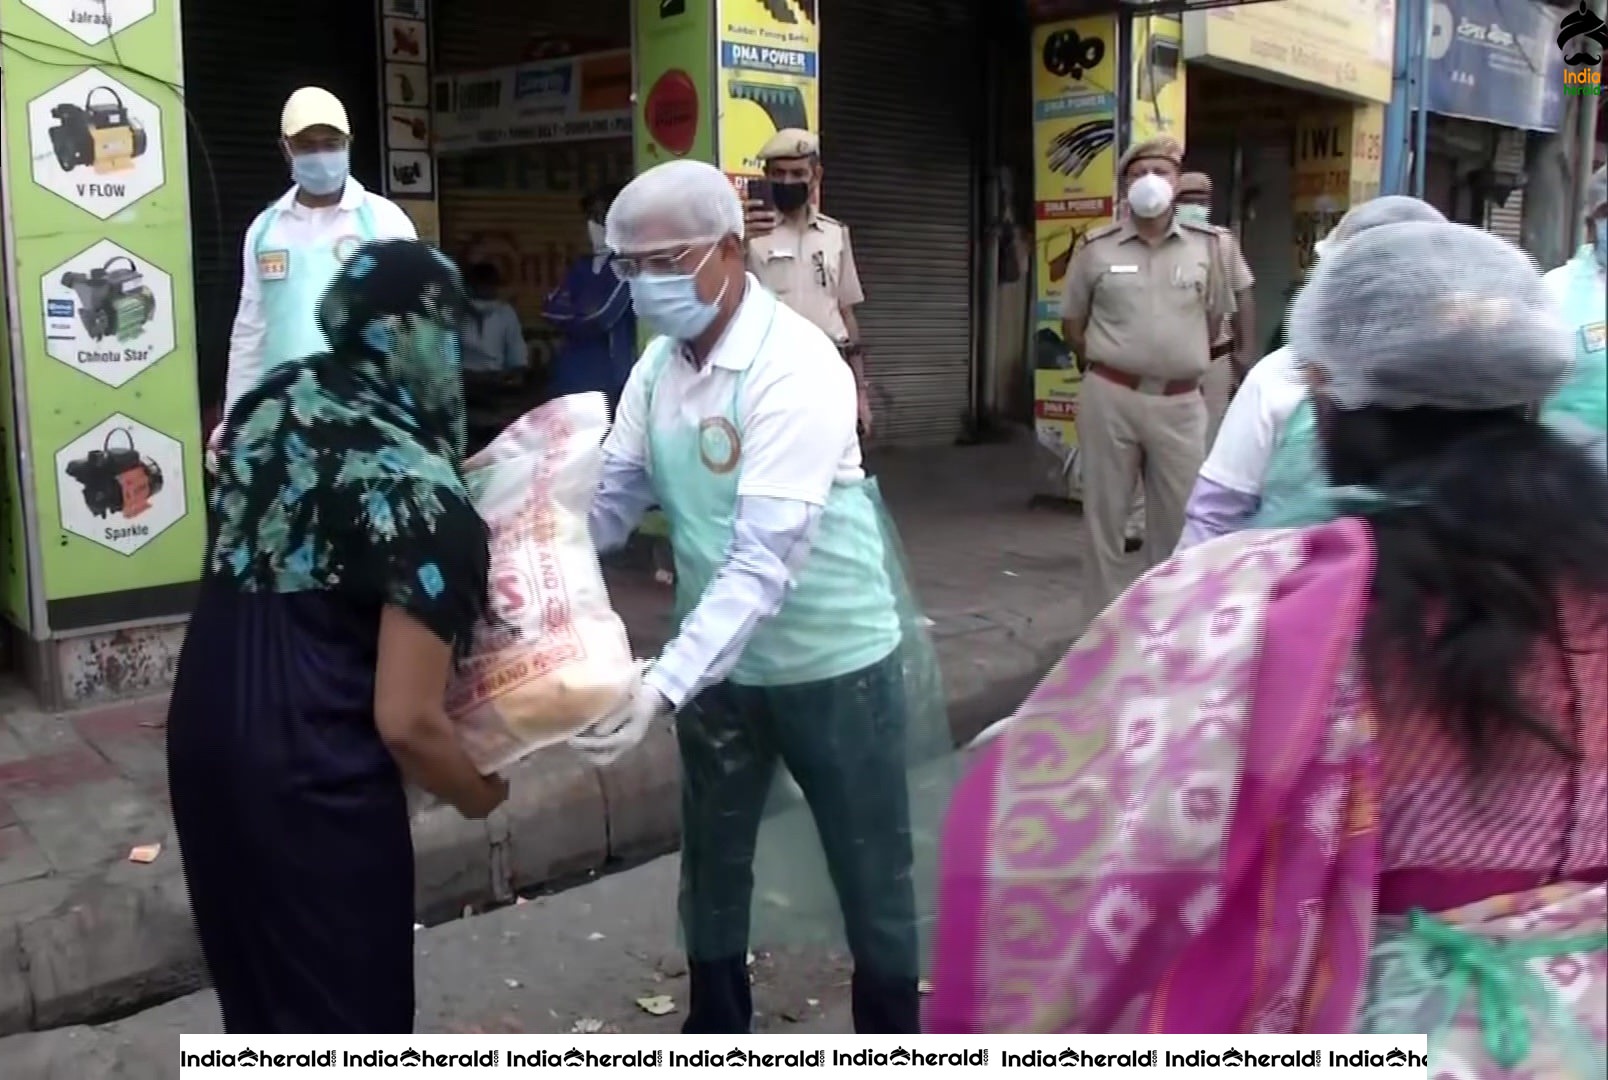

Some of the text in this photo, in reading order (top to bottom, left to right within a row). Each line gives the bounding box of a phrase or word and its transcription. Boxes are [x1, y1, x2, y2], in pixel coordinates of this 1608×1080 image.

[732, 44, 806, 66] DNA POWER
[76, 183, 126, 197] V FLOW
[77, 348, 148, 363] Chhotu Star
[104, 525, 149, 541] Sparkle
